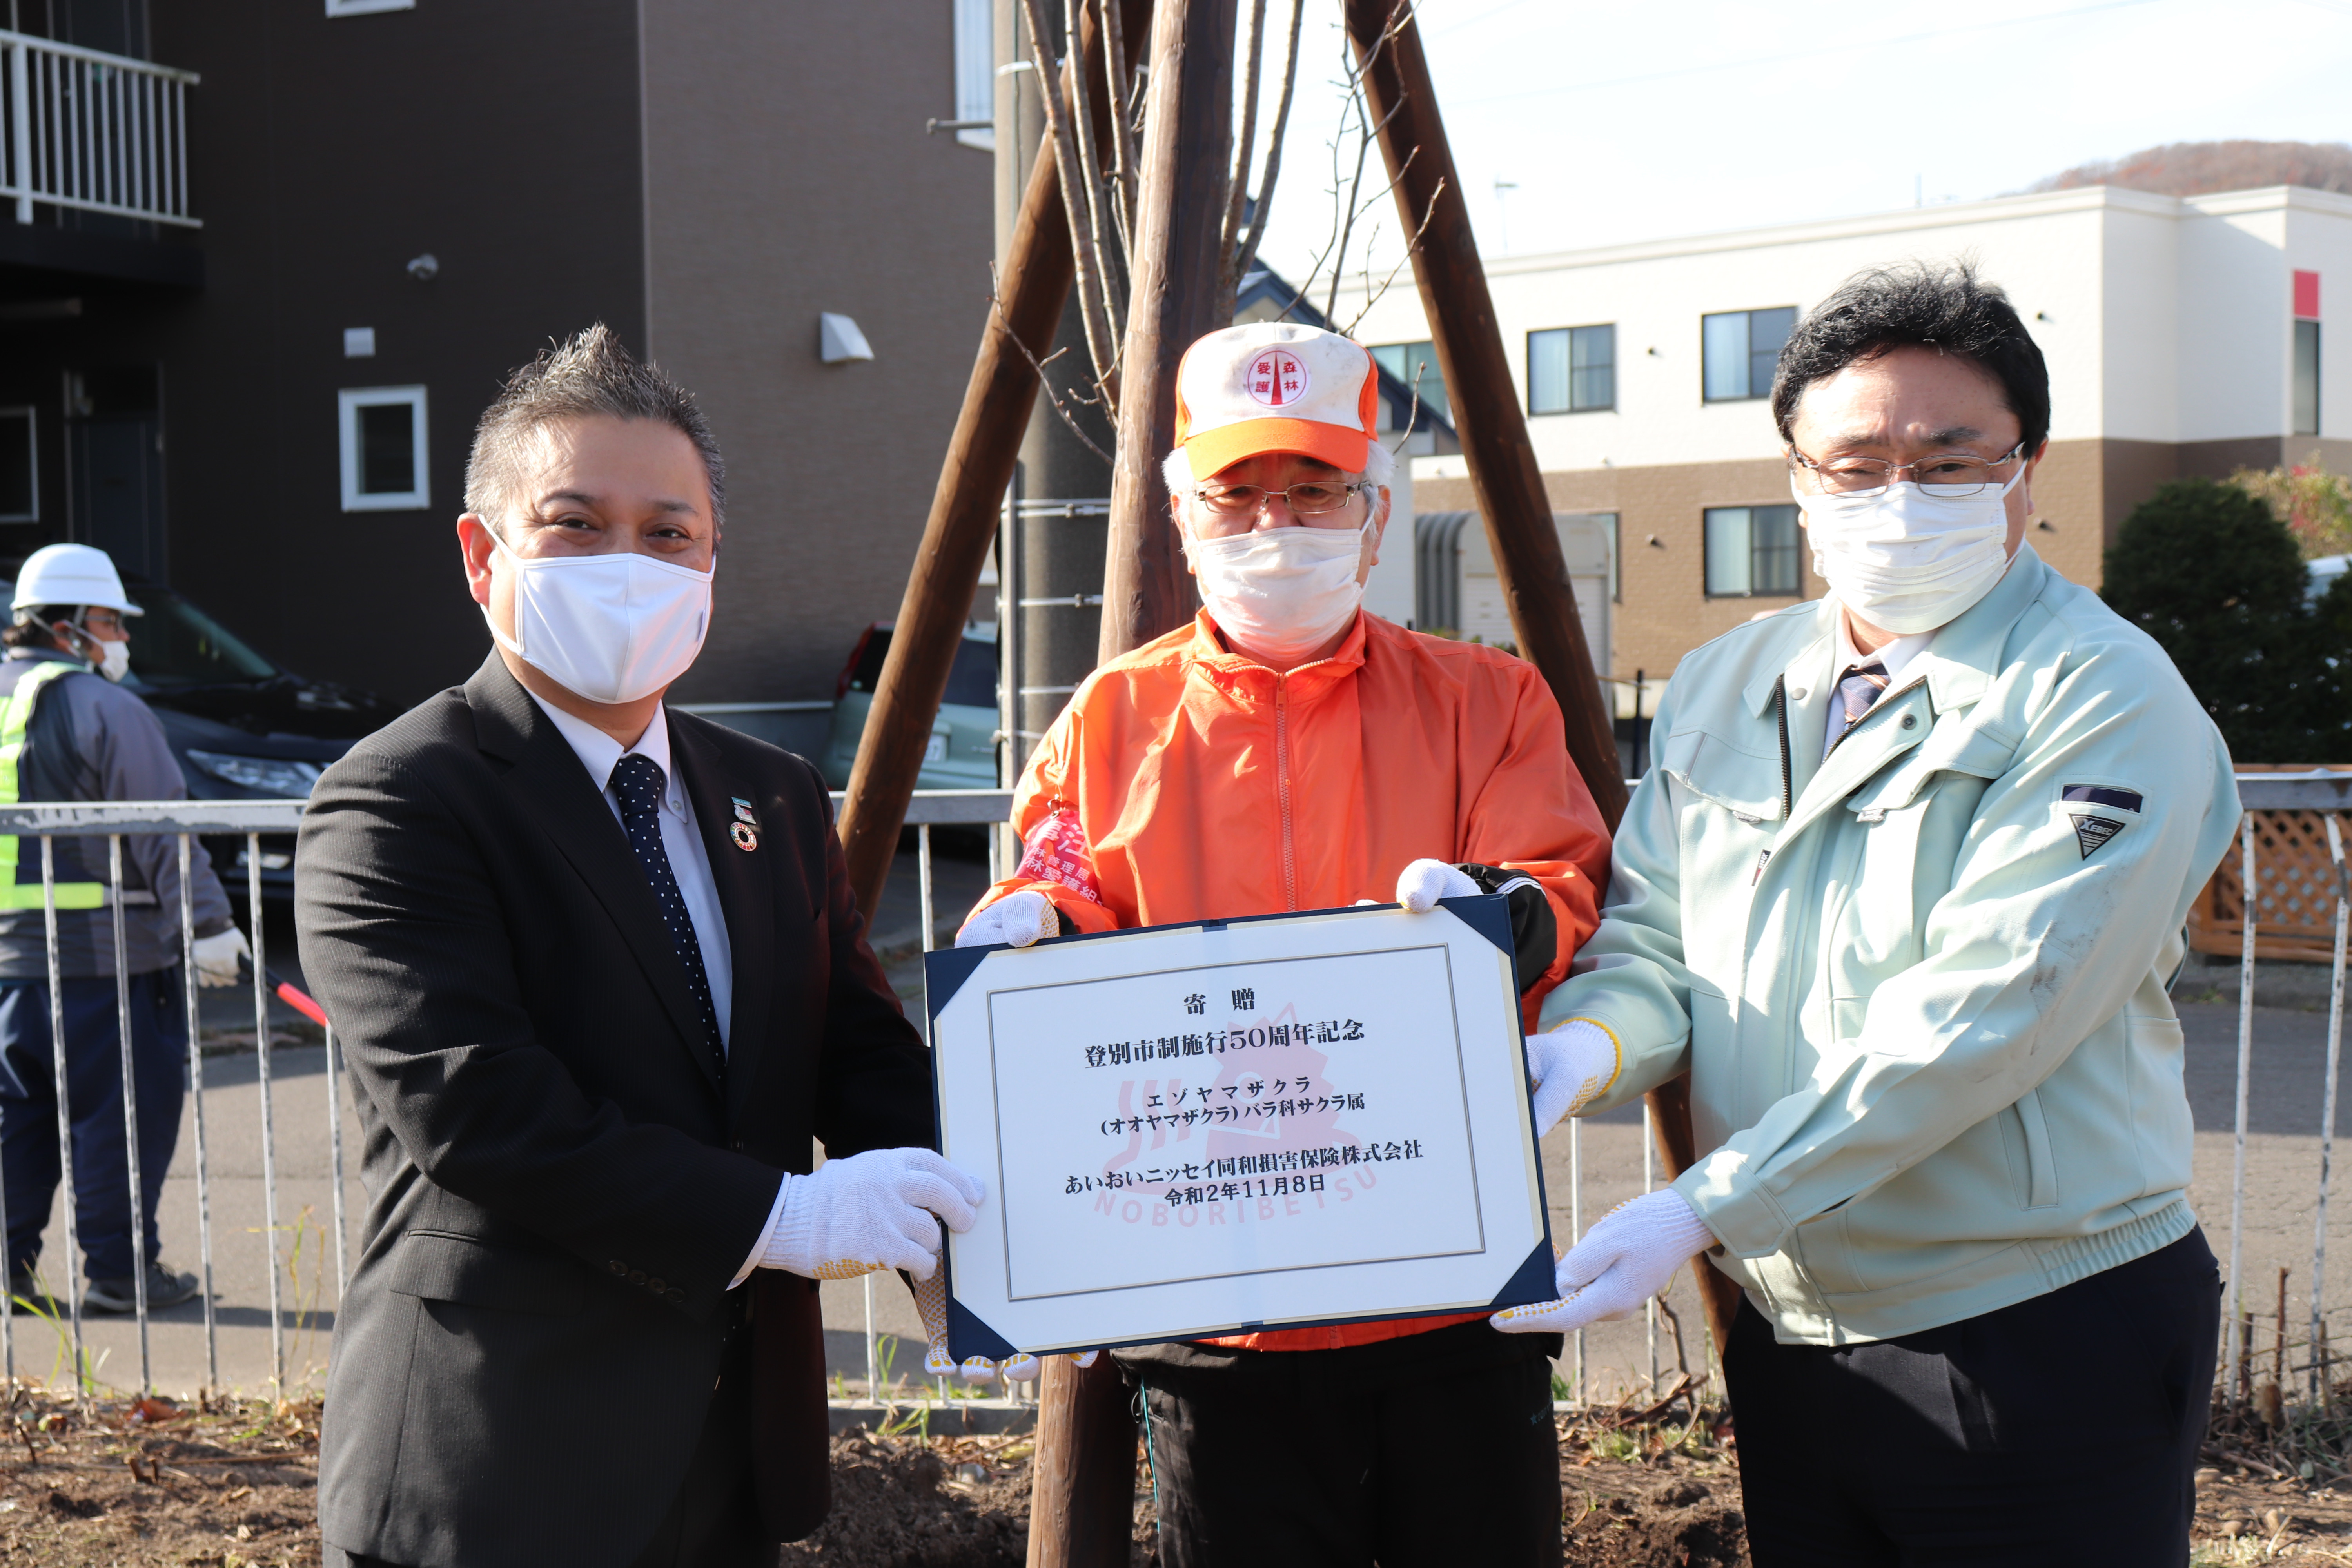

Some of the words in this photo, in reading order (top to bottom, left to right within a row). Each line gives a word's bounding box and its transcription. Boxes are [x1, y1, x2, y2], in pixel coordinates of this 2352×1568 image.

[2079, 818, 2114, 836] XEBEC
[1085, 1019, 1365, 1068] 登別市制施行50周年記念
[1147, 1077, 1310, 1107] エゾヤマザクラ
[1066, 1140, 1423, 1194] あいおいニッセイ同和損害保険株式会社
[1094, 1163, 1377, 1227] NOBORIBETSU
[1165, 1174, 1324, 1207] 令和2年11月8日
